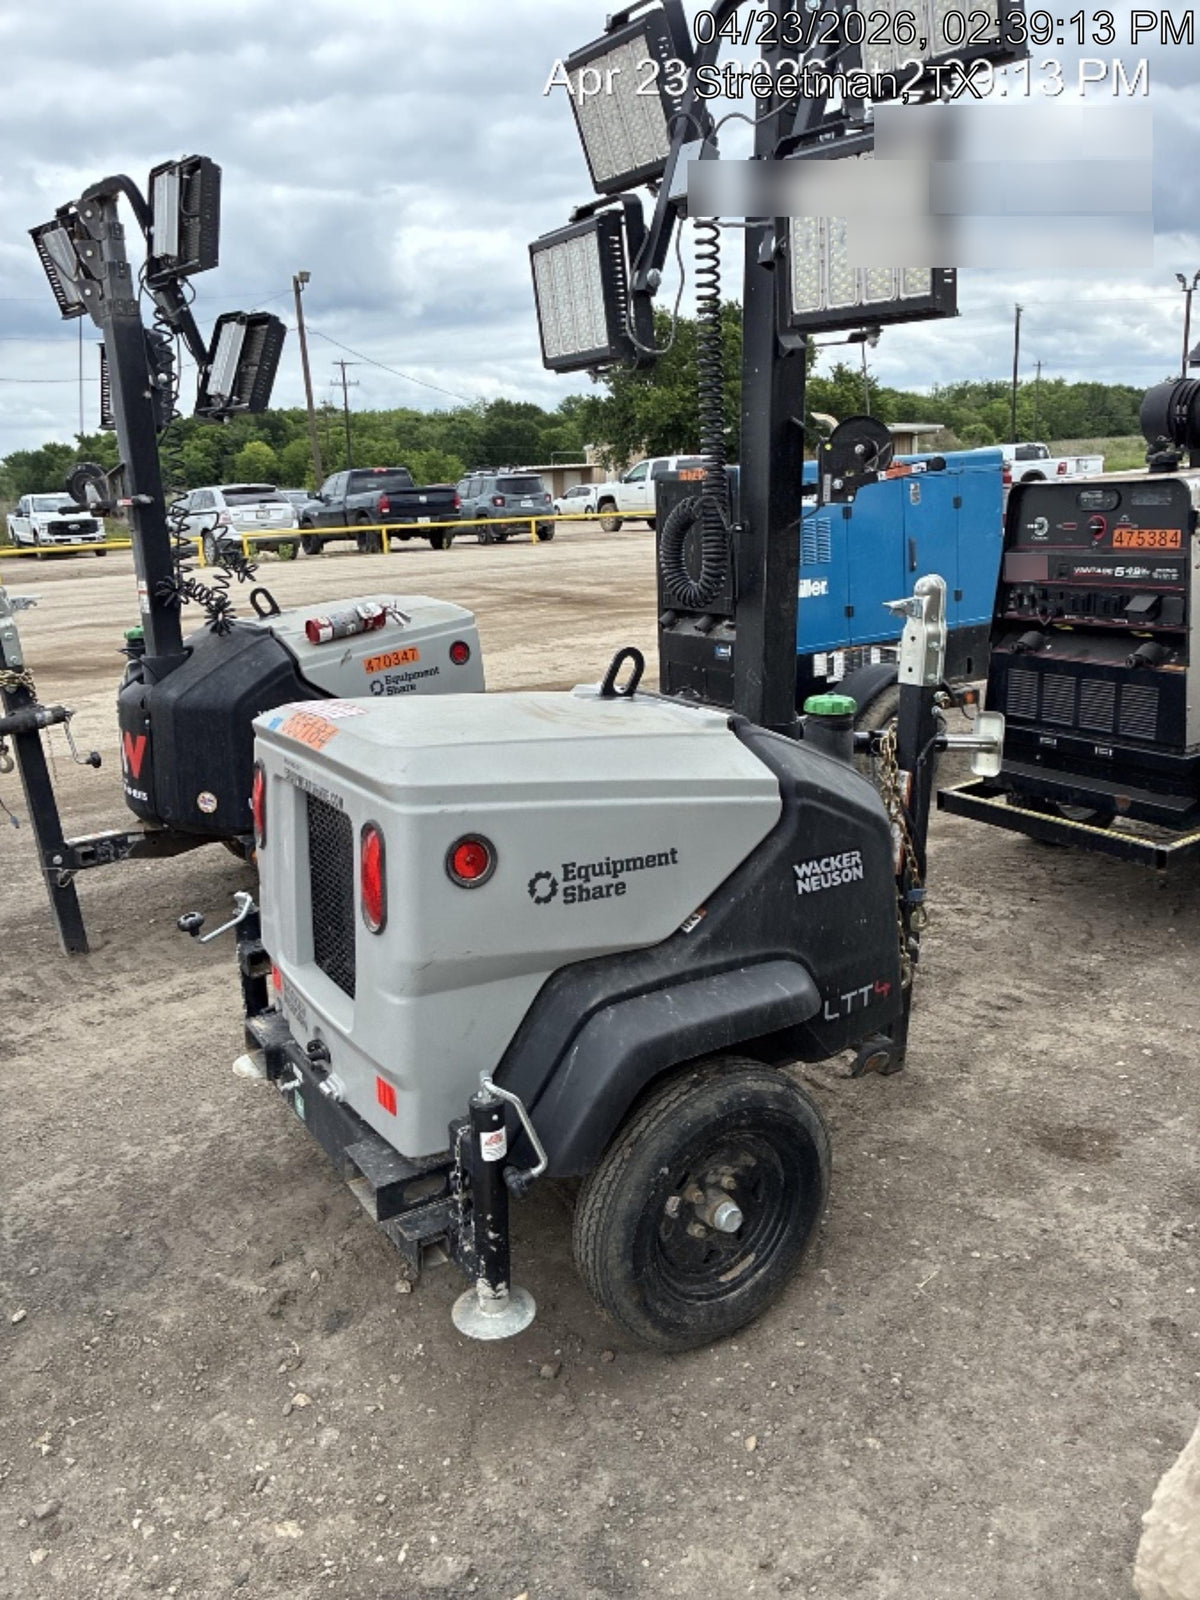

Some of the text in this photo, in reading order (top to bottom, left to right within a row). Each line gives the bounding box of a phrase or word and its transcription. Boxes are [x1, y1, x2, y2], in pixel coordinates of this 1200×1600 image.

[1114, 531, 1180, 547] 475384
[798, 578, 829, 598] iller
[365, 647, 418, 673] 470347
[384, 666, 440, 684] Equipment
[561, 847, 679, 884] Equipment
[793, 851, 862, 878] WACKER
[562, 879, 627, 905] Share
[795, 865, 864, 895] NEUSON
